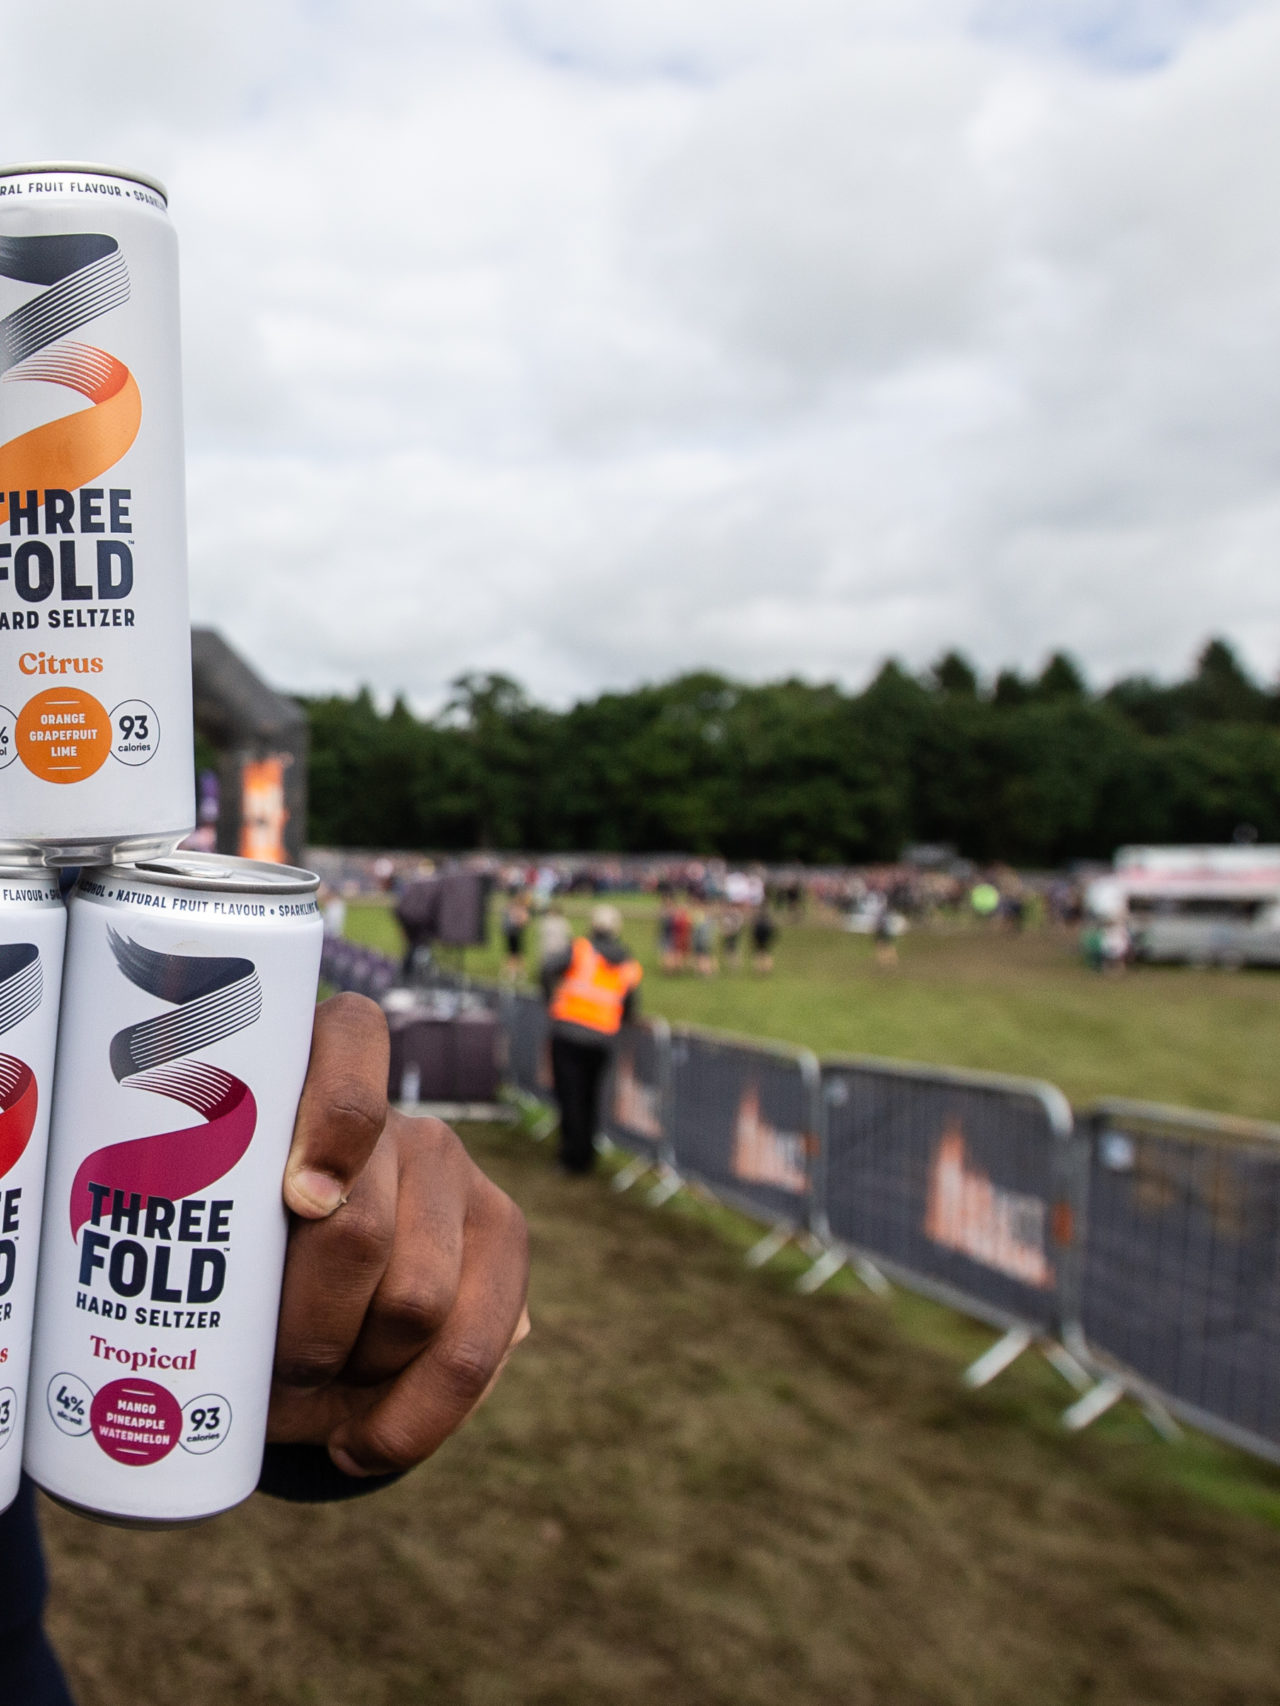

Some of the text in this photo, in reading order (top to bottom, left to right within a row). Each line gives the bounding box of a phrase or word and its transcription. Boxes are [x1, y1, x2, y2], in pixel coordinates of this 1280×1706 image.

[28, 181, 64, 193] FRUIT
[70, 182, 123, 197] FLAVOUR
[48, 608, 135, 629] SELTZER
[18, 651, 104, 676] Citrus
[40, 713, 86, 726] ORANGE
[118, 714, 149, 741] 93
[29, 728, 98, 742] GRAPEFRUIT
[50, 746, 78, 758] LIME
[117, 743, 151, 753] calories
[3, 888, 44, 902] FLAVOUR
[116, 888, 168, 909] NATURAL
[172, 897, 210, 914] FRUIT
[213, 901, 266, 917] FLAVOUR
[87, 1181, 234, 1243] THREE
[76, 1291, 221, 1329] HARD SELTZER
[89, 1334, 197, 1371] Tropical
[56, 1385, 85, 1416] 4%
[117, 1399, 157, 1415] MANGO
[106, 1411, 166, 1431] PINEAPPLE
[190, 1406, 220, 1432] 93
[98, 1425, 171, 1446] WATERMELON
[186, 1432, 220, 1443] calories
